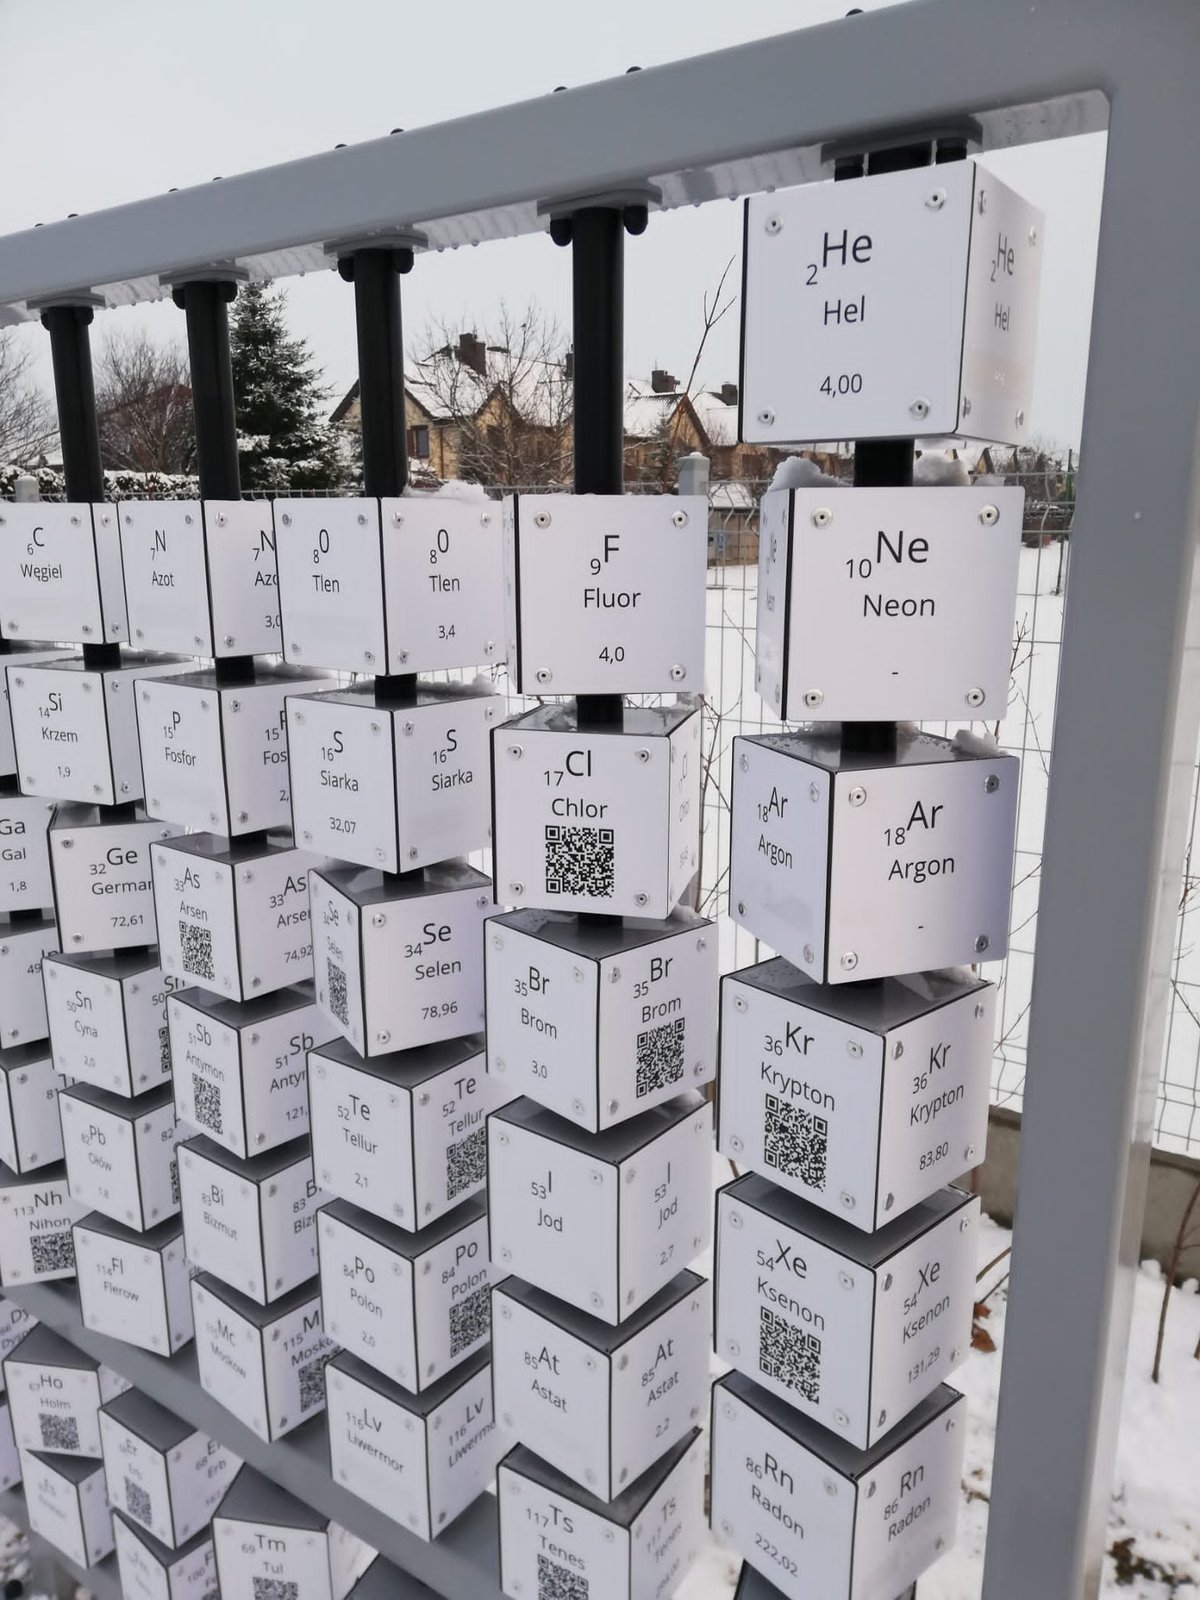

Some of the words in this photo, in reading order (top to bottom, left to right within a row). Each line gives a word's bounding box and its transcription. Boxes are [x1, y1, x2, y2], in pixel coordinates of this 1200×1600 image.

[824, 296, 865, 326] Hel
[994, 302, 1010, 332] Hel
[820, 374, 863, 398] 4,00
[20, 563, 63, 582] Węgiel
[152, 571, 174, 587] Azot
[254, 570, 278, 587] Azo
[312, 574, 340, 593] Tlen
[429, 575, 460, 593] Tlen
[583, 588, 641, 608] Fluor
[863, 594, 936, 618] Neon
[438, 625, 456, 640] 3,4
[599, 646, 625, 664] 4,0
[41, 727, 78, 743] Krzem
[165, 747, 196, 767] Fosfor
[263, 750, 288, 765] Fos
[57, 766, 71, 777] 1,9
[320, 769, 359, 792] Siarka
[432, 769, 473, 791] Siarka
[280, 789, 290, 802] 2,
[551, 798, 608, 818] Chlor
[329, 817, 357, 834] 32,07
[1, 848, 26, 861] Gal
[758, 834, 793, 869] Argon
[888, 856, 955, 883] Argon
[9, 881, 27, 892] 1,8
[111, 915, 143, 927] 72,61
[180, 900, 208, 922] Arsen
[284, 944, 313, 963] 74,92
[415, 960, 461, 980] Selen
[422, 1002, 458, 1020] 78,96
[642, 997, 681, 1023] Brom
[75, 1020, 98, 1038] Cyna
[521, 1008, 557, 1040] Brom
[186, 1050, 225, 1082] Antymon
[531, 1060, 548, 1079] 3,0
[269, 1070, 306, 1093] Anty
[761, 1061, 836, 1112] Krypton
[910, 1084, 965, 1127] Krypton
[449, 1109, 484, 1137] Tellur
[343, 1128, 378, 1154] Tellur
[919, 1142, 949, 1171] 83,80
[355, 1172, 368, 1188] 2,1
[29, 1216, 72, 1231] Nihon
[537, 1208, 563, 1232] Jod
[658, 1196, 678, 1229] Jod
[104, 1281, 140, 1302] Flerow
[451, 1269, 487, 1300] Polon
[350, 1287, 383, 1319] Polon
[757, 1276, 825, 1331] Ksenon
[902, 1295, 950, 1344] Ksenon
[291, 1337, 334, 1368] Mosko
[908, 1346, 940, 1383] 131,29
[532, 1379, 568, 1414] Astat
[648, 1371, 679, 1407] Astat
[40, 1398, 71, 1411] Holm
[346, 1430, 404, 1473] Liwermor
[448, 1421, 496, 1468] Liwermo
[752, 1484, 804, 1540] Radon
[888, 1496, 932, 1542] Radon
[539, 1534, 586, 1571] Tenes
[754, 1532, 798, 1578] 222,02
[262, 1561, 284, 1575] Tul
